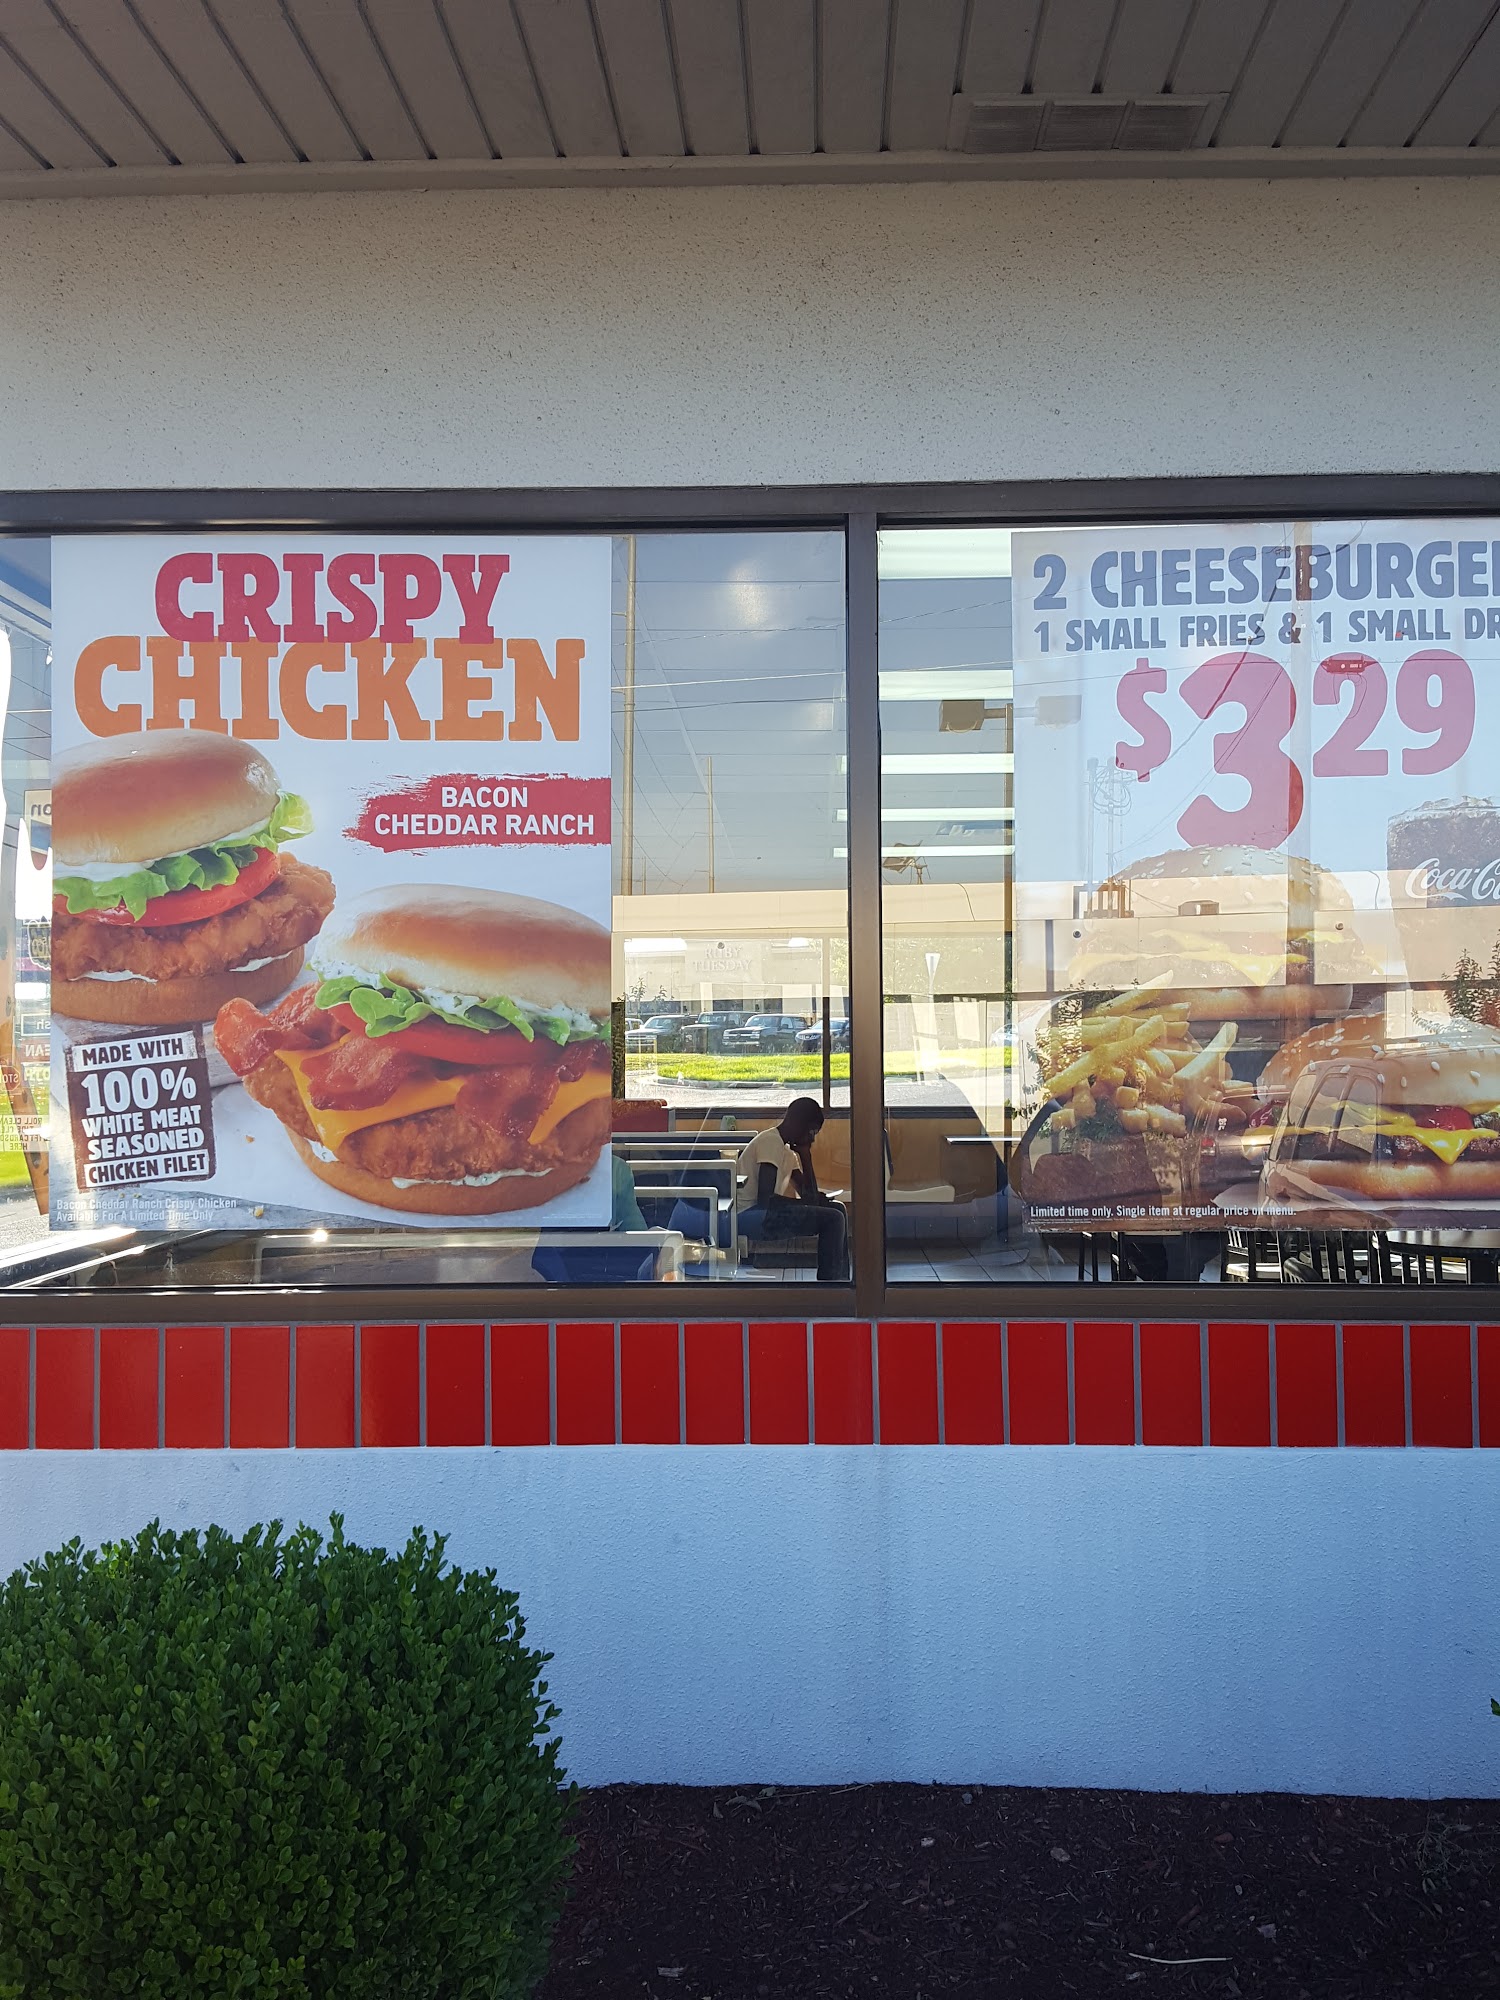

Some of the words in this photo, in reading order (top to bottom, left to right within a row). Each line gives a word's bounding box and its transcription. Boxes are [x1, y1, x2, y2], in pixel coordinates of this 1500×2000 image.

[1033, 553, 1068, 611] 2
[155, 552, 510, 644] CRISPY
[1034, 621, 1050, 652] 1
[1066, 616, 1166, 651] SMALL
[1179, 613, 1264, 647] FRIES
[1277, 611, 1301, 645] &
[1316, 611, 1331, 642] 1
[1348, 608, 1451, 643] SMALL
[74, 635, 586, 741] CHICKEN
[441, 786, 528, 808] BACON
[374, 813, 498, 836] CHEDDAR
[505, 814, 595, 836] RANCH
[692, 959, 752, 973] TUESDAY
[705, 946, 742, 959] RUBY
[82, 1044, 132, 1067] MADE
[137, 1037, 184, 1060] WITH
[81, 1066, 197, 1116] 100%
[81, 1112, 145, 1138] WHITE
[150, 1104, 202, 1130] MEAT
[87, 1127, 205, 1161] SEASONED
[88, 1159, 159, 1184] CHICKEN
[164, 1153, 206, 1174] FILET
[56, 1211, 99, 1221] Available
[102, 1211, 118, 1221] For
[121, 1211, 127, 1221] A
[129, 1211, 165, 1221] Limited
[167, 1210, 190, 1220] Time
[193, 1210, 214, 1221] Only
[57, 1200, 87, 1210] Bacon
[90, 1199, 129, 1209] Cheddar
[132, 1199, 162, 1209] Ranch
[165, 1199, 195, 1211] Crispy
[198, 1198, 237, 1208] Chicken
[1030, 1206, 1065, 1217] Limited
[1068, 1206, 1089, 1217] time
[1092, 1206, 1114, 1218] only.
[1116, 1205, 1146, 1218] Single
[1148, 1205, 1170, 1216] item
[1173, 1206, 1183, 1216] at
[1185, 1205, 1221, 1218] regular
[1224, 1205, 1249, 1218] price
[1266, 1207, 1297, 1216] menu.
